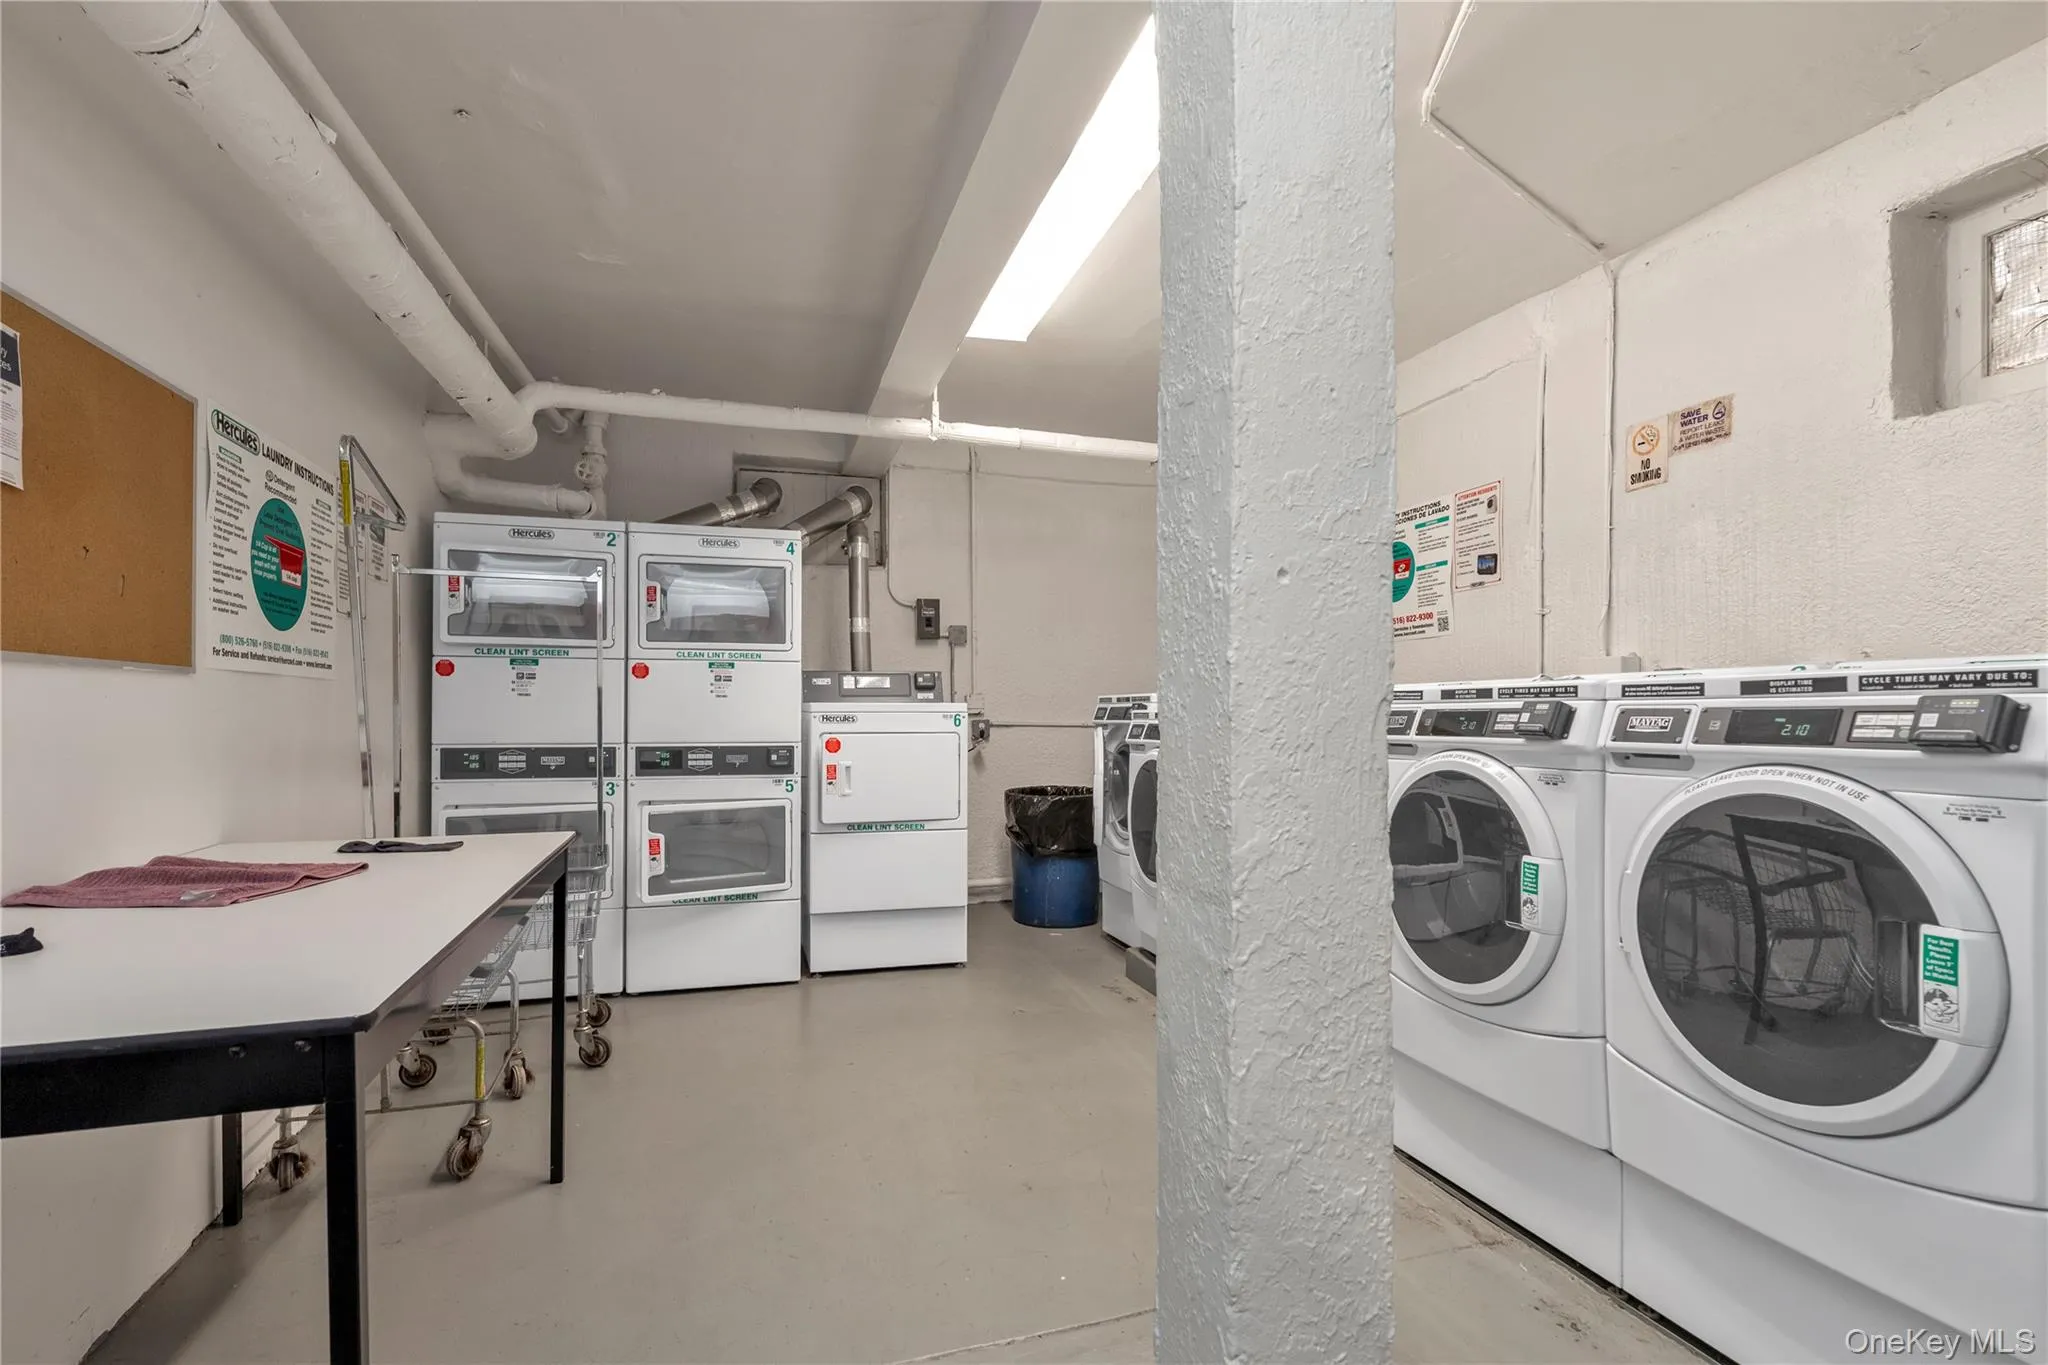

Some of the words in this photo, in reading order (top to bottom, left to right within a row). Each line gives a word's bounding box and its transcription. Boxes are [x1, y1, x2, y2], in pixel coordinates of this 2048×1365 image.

[1681, 408, 1701, 419] SAVE
[1680, 414, 1708, 427] WATER
[216, 410, 257, 452] Hercules
[1680, 425, 1703, 435] REPORT
[1705, 419, 1724, 428] LEAKS
[1685, 432, 1704, 440] WATER
[1705, 426, 1725, 435] WASTE
[262, 442, 293, 471] LAUNDRY
[295, 462, 334, 496] INSTRUCTIONS
[1641, 458, 1650, 470] NO
[1630, 468, 1661, 485] SMOKING
[265, 482, 297, 505] Recommended
[1401, 500, 1441, 517] INSTRUCTIONS
[1428, 504, 1450, 516] LAVADO
[512, 529, 552, 539] Hercules
[606, 532, 616, 547] 2
[702, 538, 737, 547] Hercules
[786, 542, 795, 555] 4
[1406, 612, 1433, 622] 822-9300
[221, 648, 239, 658] Service
[241, 651, 249, 659] and
[474, 648, 506, 656] CLEAN
[509, 648, 529, 656] LINT
[532, 649, 569, 657] SCREEN
[1862, 676, 1891, 684] CYCLE
[1929, 674, 1950, 682] MAY
[1954, 673, 1981, 681] VARY
[2013, 672, 2032, 680] TO:
[954, 714, 961, 727] 6
[1630, 718, 1669, 727] MAYTAG
[606, 782, 615, 796] 3
[785, 779, 794, 792] 5
[1684, 782, 1707, 795] PLEASE
[1710, 773, 1734, 784] LEAVE
[1735, 769, 1759, 778] DOOR
[1786, 771, 1812, 781] WHEN
[1814, 776, 1836, 788] NOT
[1835, 782, 1847, 792] IN
[1848, 788, 1870, 802] USE
[703, 895, 721, 903] LINT
[724, 893, 758, 902] SCREEN
[1929, 951, 1951, 960] Please
[1932, 972, 1956, 981] Washer
[1934, 967, 1954, 975] Space
